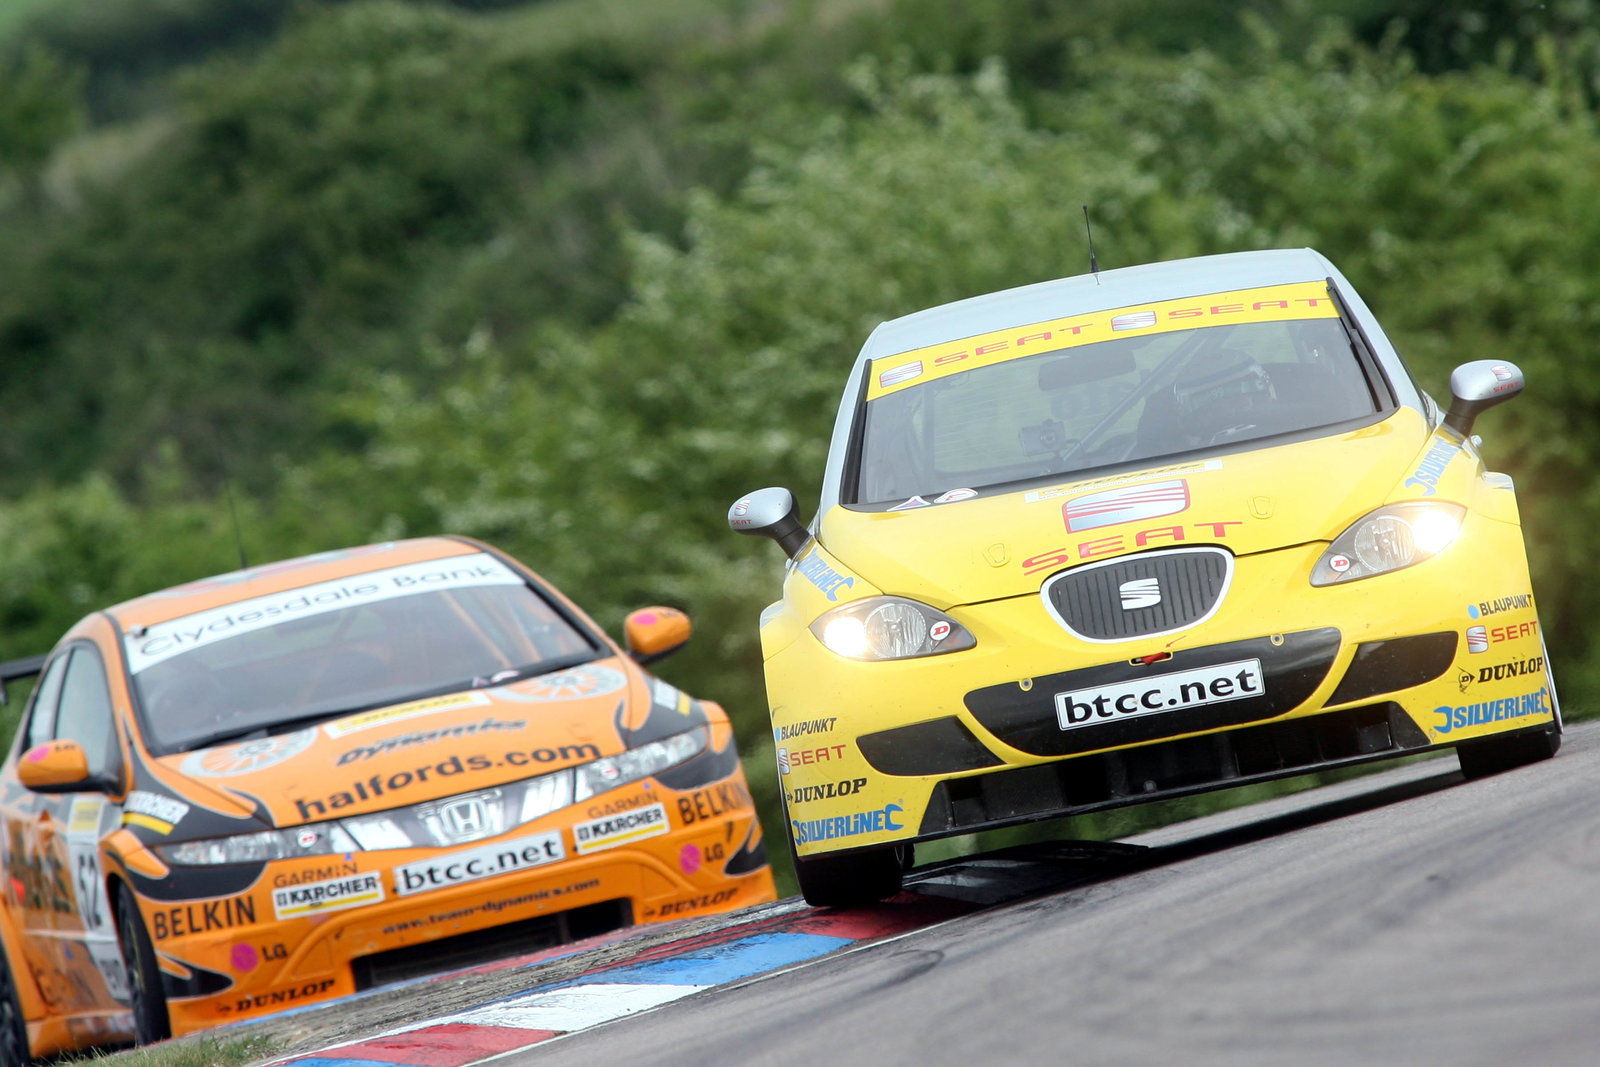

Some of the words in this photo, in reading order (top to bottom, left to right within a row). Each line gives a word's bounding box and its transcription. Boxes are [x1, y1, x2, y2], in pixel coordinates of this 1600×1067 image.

[934, 323, 1093, 367] SEAT
[1168, 298, 1331, 320] SEAT
[1022, 521, 1243, 576] SEAT
[140, 583, 381, 657] Clydesdale
[392, 563, 500, 587] Bank
[1479, 593, 1533, 617] BLAUPUNKT
[1491, 621, 1537, 643] SEAT
[1477, 656, 1543, 684] DUNLOP
[1064, 668, 1258, 724] btcc.net
[781, 718, 837, 740] BLAUPUNKT
[790, 744, 847, 767] SEAT
[295, 740, 602, 820] halfords.com
[794, 777, 867, 804] DUNLOP
[402, 838, 558, 891] btcc.net
[704, 843, 724, 863] LG
[273, 861, 358, 888] GARMIN
[153, 895, 257, 941] BELKIN
[261, 943, 288, 962] LG
[235, 979, 336, 1013] DUNLOP
